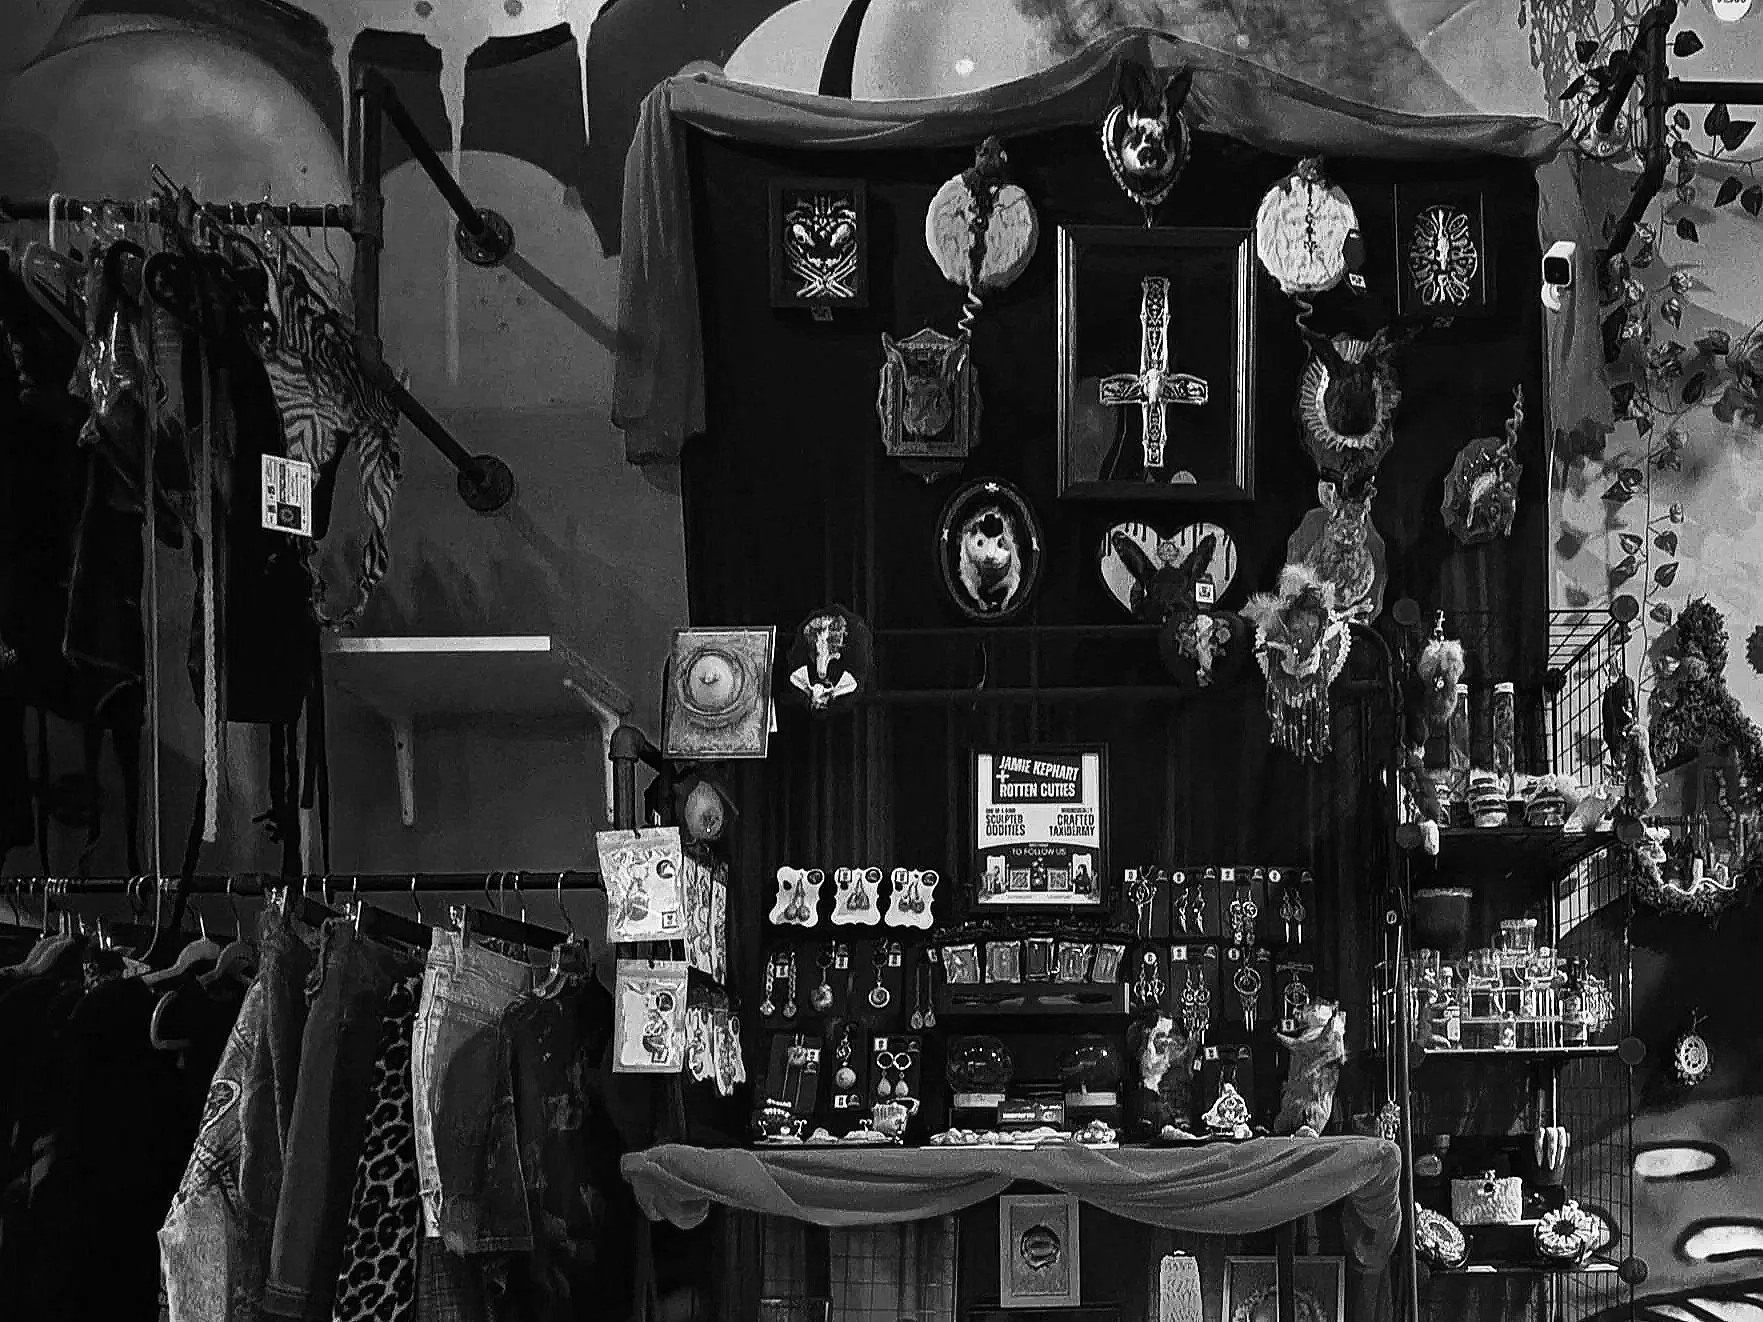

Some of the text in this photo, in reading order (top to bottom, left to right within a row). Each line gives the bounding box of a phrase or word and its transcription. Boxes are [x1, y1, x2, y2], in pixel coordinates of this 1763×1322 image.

[999, 755, 1080, 781] JAMIE KEPHART
[1000, 782, 1076, 798] ROTTEN CUTIES
[1057, 814, 1095, 826] CRAFTED
[985, 824, 1026, 836] ODDITIES
[1049, 825, 1095, 837] TAXIDERMY
